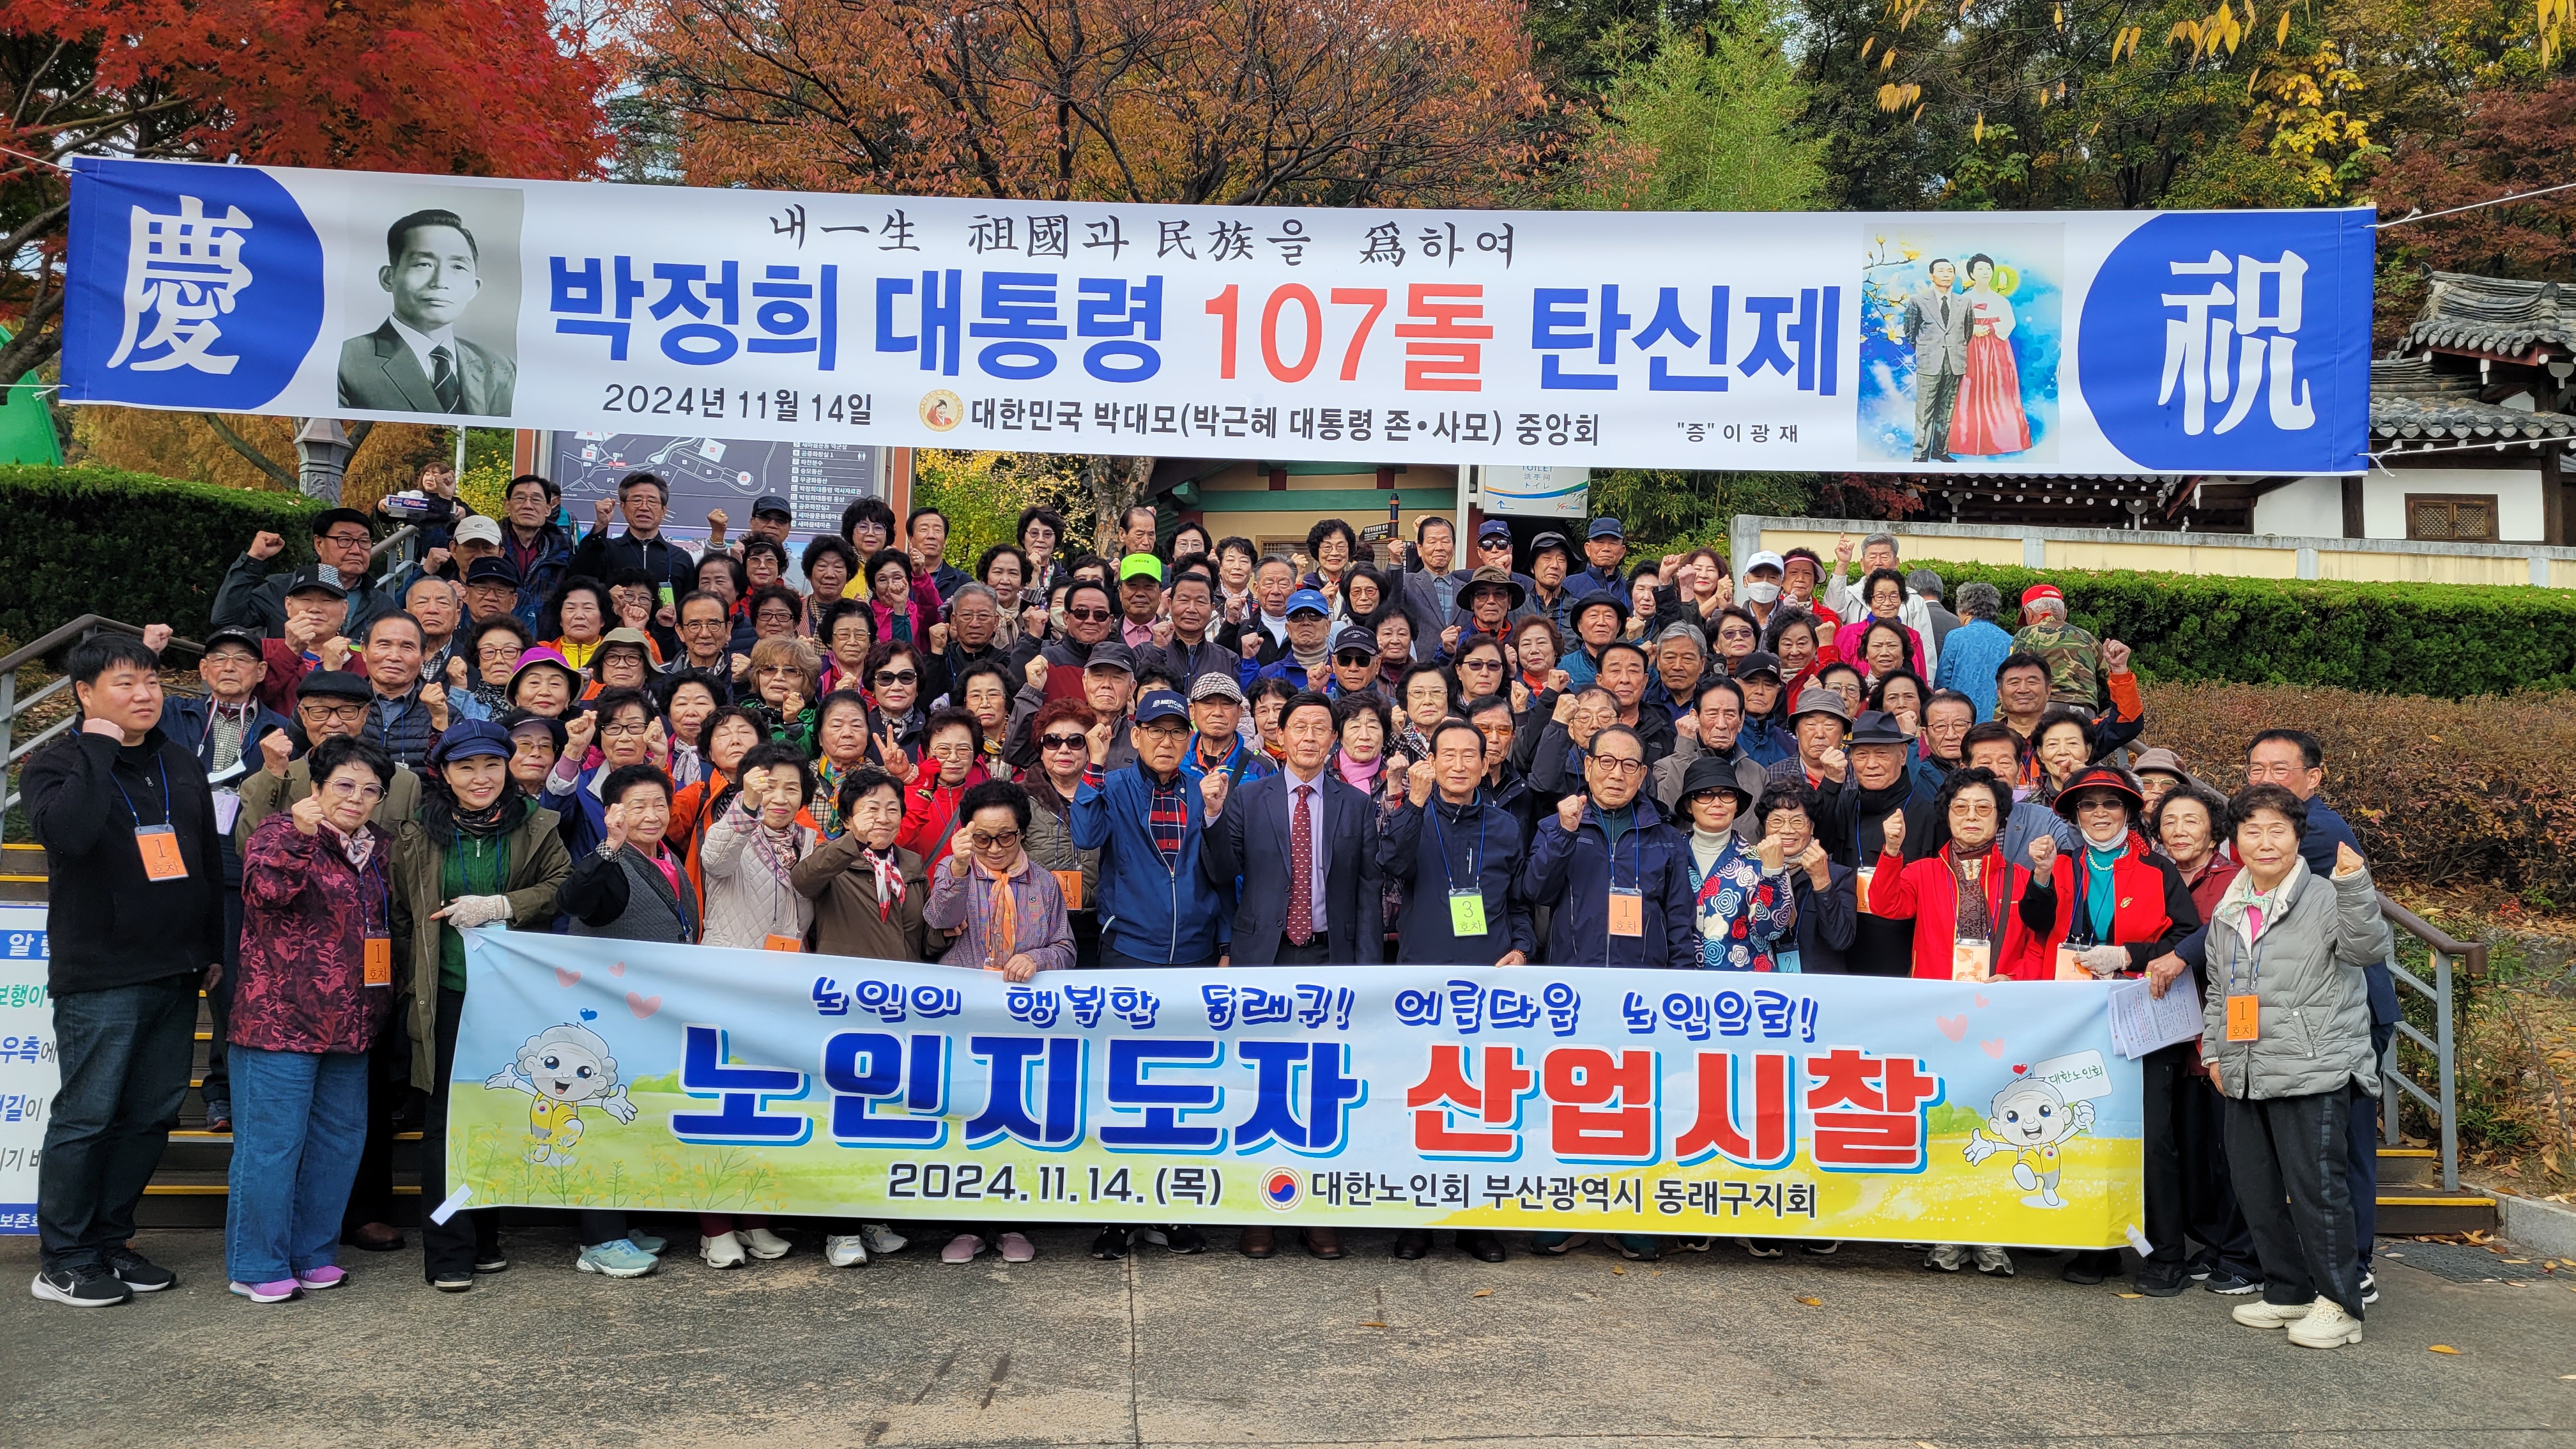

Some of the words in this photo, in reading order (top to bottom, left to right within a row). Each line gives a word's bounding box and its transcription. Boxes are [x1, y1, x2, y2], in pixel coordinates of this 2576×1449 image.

[107, 195, 253, 375] 慶
[549, 256, 838, 371] 박정희
[876, 269, 1163, 383] 대통령
[1205, 283, 1493, 392] 107돌
[1532, 284, 1841, 395] 탄신제
[2158, 249, 2315, 436] 祝
[602, 384, 726, 418] 2024년
[739, 389, 799, 422] 11월
[811, 394, 872, 425] 14일
[972, 397, 1082, 433] 대한민국
[1094, 401, 1277, 440] 박대모(박근혜
[1289, 407, 1373, 441] 대통령
[1516, 413, 1598, 446] 중앙회
[154, 838, 167, 858] 1
[153, 860, 180, 875] 호차
[1063, 875, 1071, 892] 1
[1066, 895, 1078, 908] 차
[1462, 901, 1474, 918] 3
[1623, 900, 1630, 917] 1
[1459, 919, 1483, 932] 호차
[1613, 920, 1639, 933] 호차
[375, 943, 381, 963] 1
[367, 967, 388, 981] 호차
[1784, 956, 1793, 973] 2
[811, 975, 962, 1023] 노인의
[1005, 984, 1160, 1030] 행복한
[1201, 983, 1354, 1031] 동래구!
[1621, 988, 1819, 1043] 노인으로!
[2239, 1000, 2246, 1021] 1
[2231, 1023, 2253, 1038] 호차
[2048, 1064, 2103, 1085] 대한노인회
[669, 1022, 1368, 1158] 노인지도자
[1407, 1043, 1946, 1174] 산업시찰
[887, 1163, 1222, 1208] 2024.11.14.(목)
[1312, 1170, 1470, 1209] 대한노인회
[1483, 1174, 1642, 1214] 부산광역시
[1654, 1179, 1816, 1218] 동래구지회
